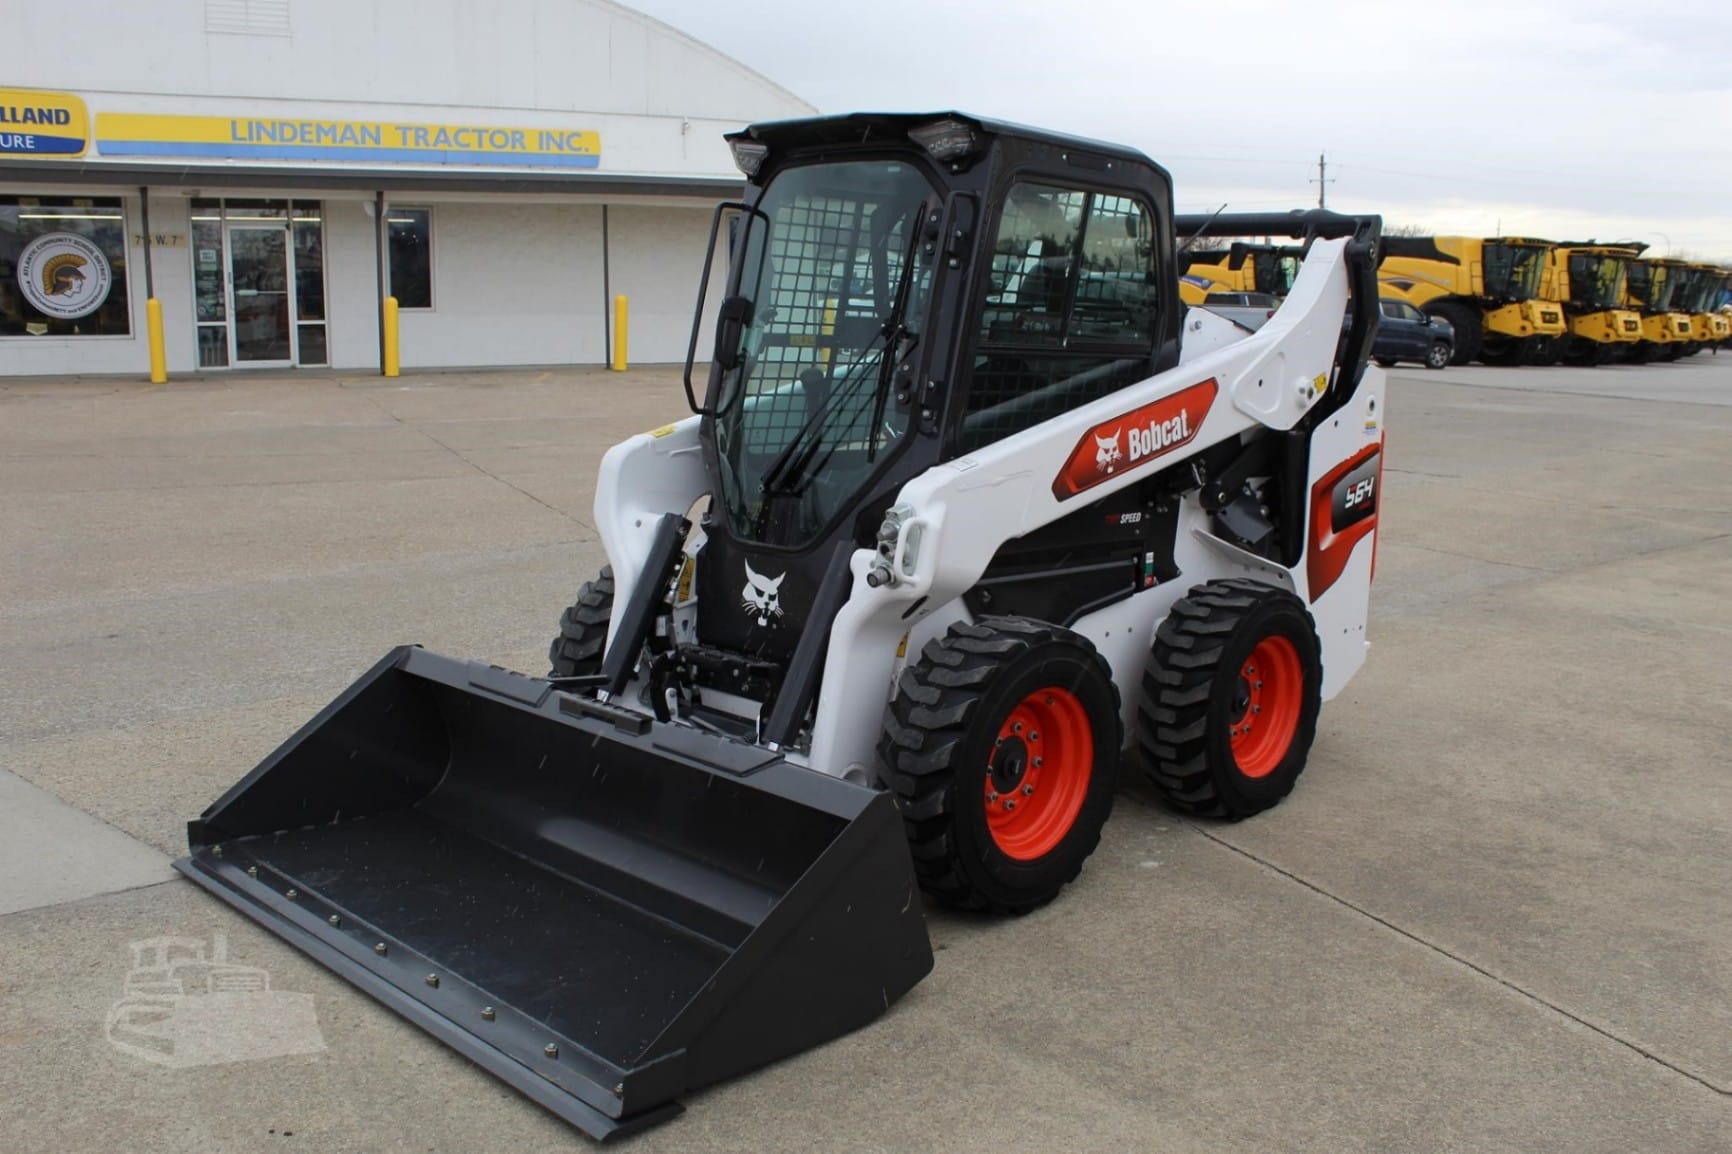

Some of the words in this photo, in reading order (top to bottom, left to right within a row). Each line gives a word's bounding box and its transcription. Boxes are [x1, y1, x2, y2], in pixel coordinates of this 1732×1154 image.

[0, 106, 70, 126] LLAND
[0, 134, 35, 149] URE
[231, 119, 381, 146] LINDEMAN
[395, 126, 526, 151] TRACTOR
[538, 131, 590, 153] INC.
[1128, 408, 1188, 462] Bobcat
[1344, 476, 1375, 509] S64
[1120, 512, 1142, 524] SPEED
